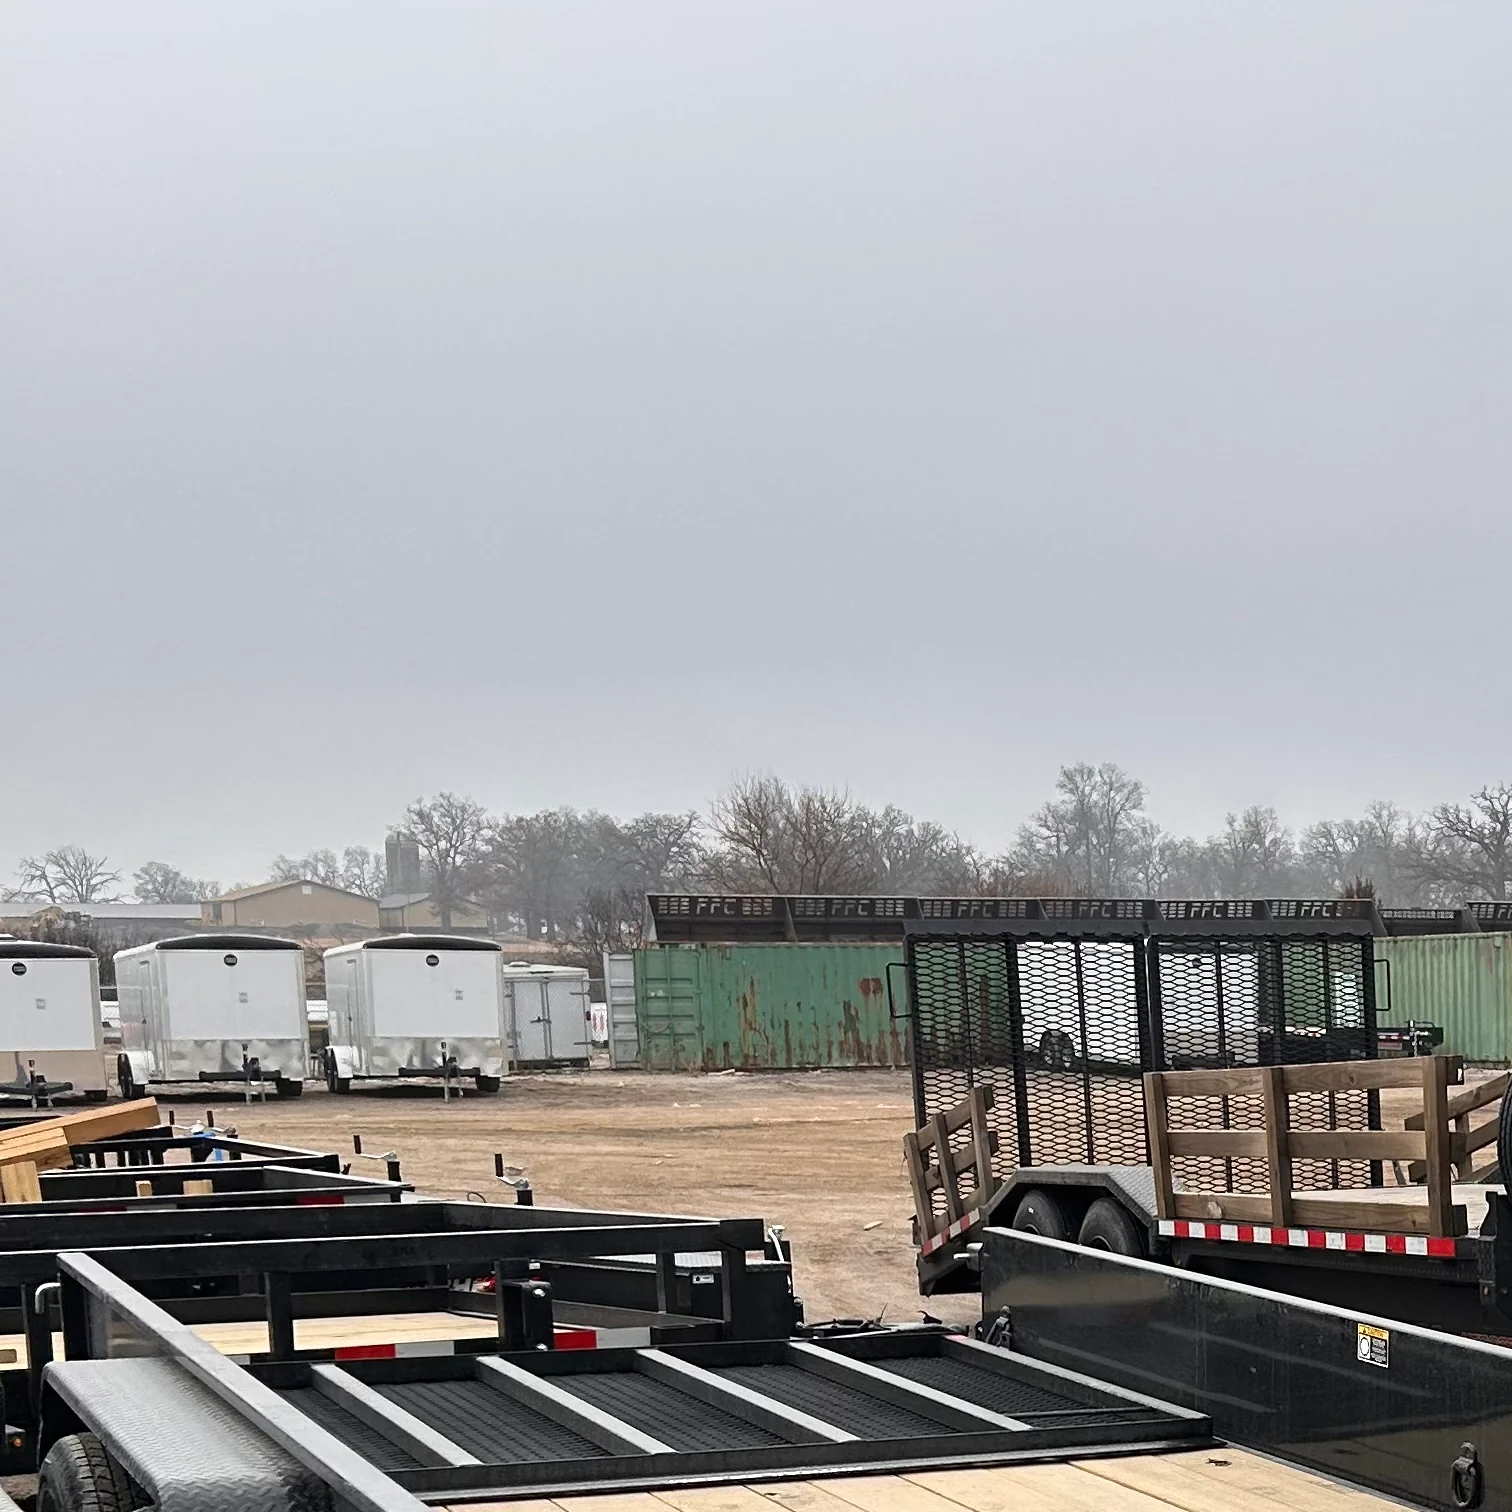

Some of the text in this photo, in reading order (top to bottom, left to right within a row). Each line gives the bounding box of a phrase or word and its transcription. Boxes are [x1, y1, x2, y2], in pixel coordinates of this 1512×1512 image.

[696, 898, 737, 915] FFC
[831, 900, 870, 916] FFC
[957, 901, 992, 917] FFC
[1078, 901, 1112, 917] FFC
[1190, 902, 1224, 918] FFC
[1300, 901, 1333, 917] FFC
